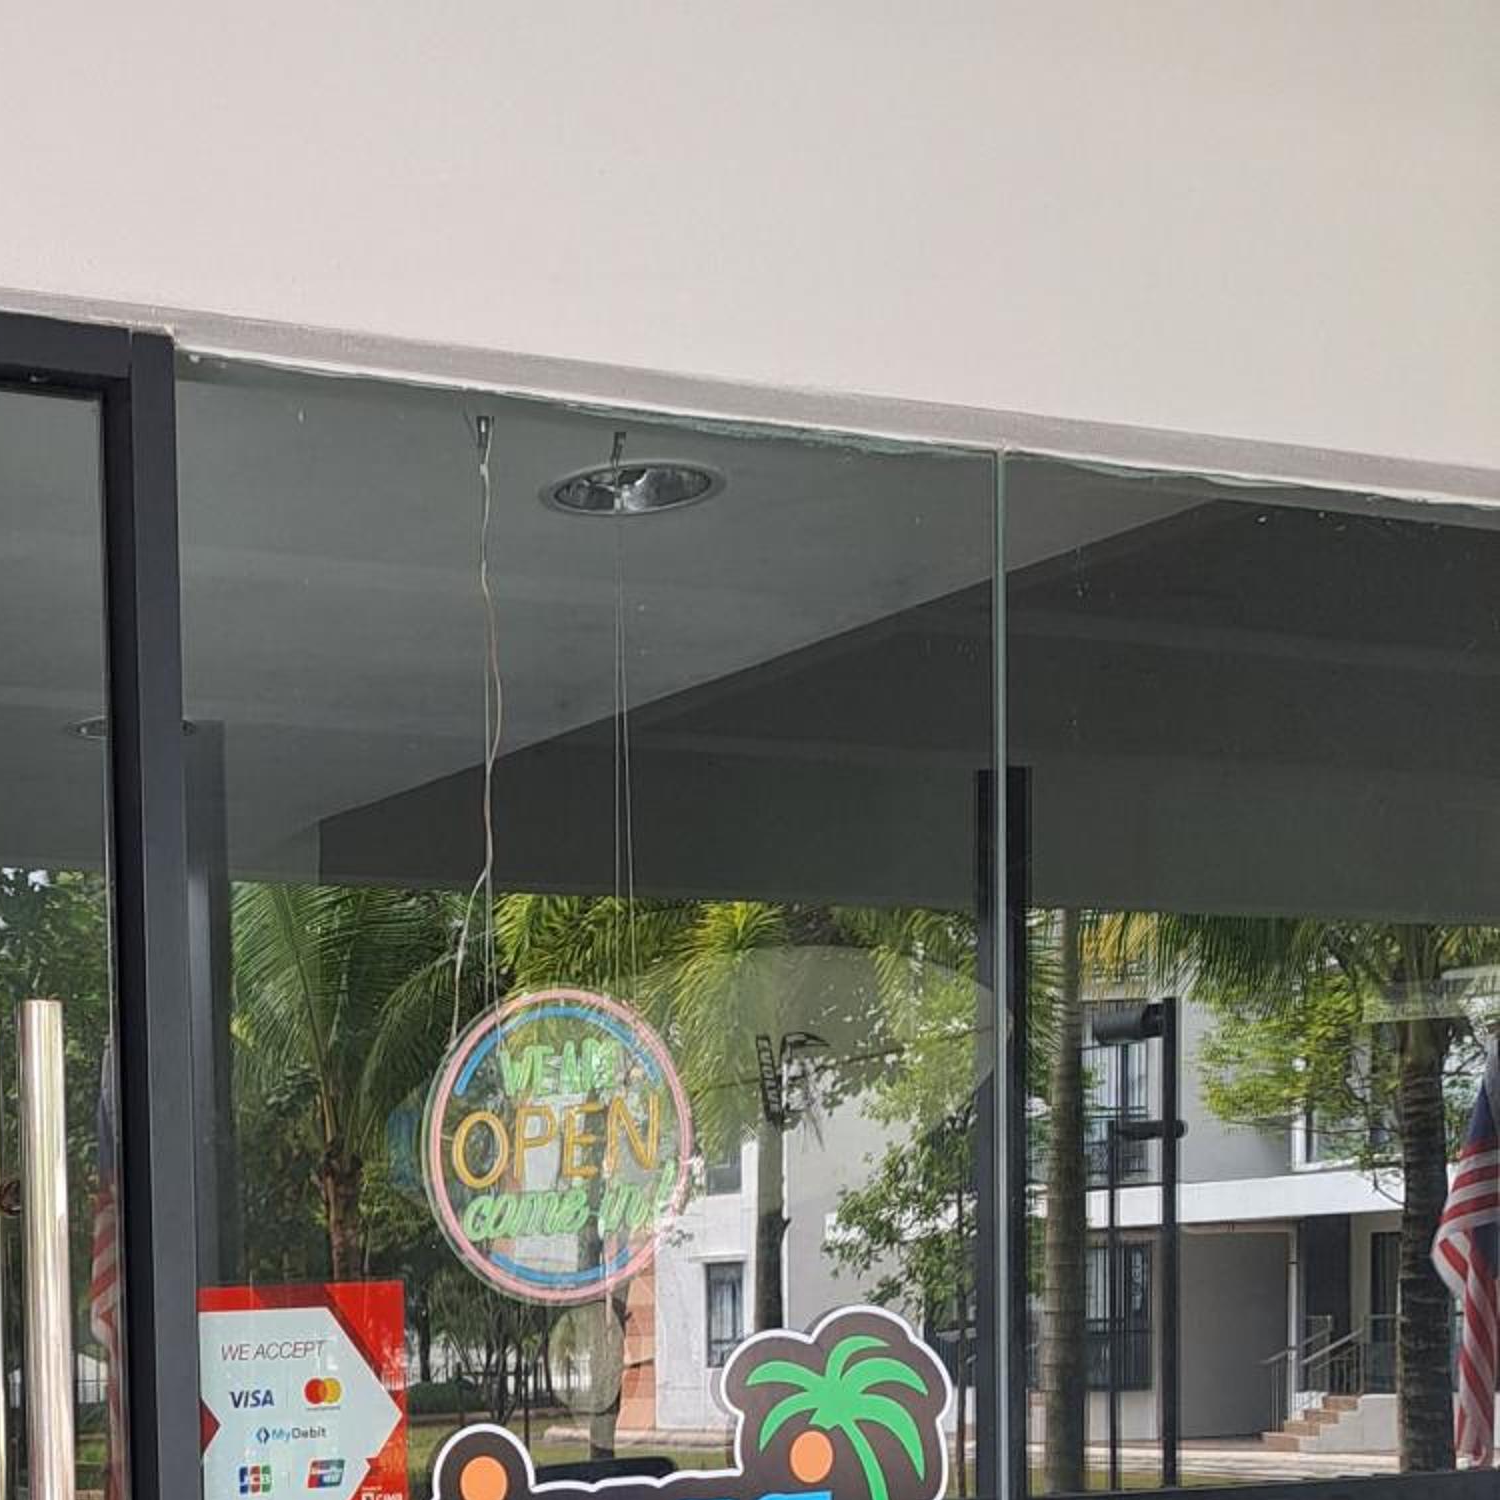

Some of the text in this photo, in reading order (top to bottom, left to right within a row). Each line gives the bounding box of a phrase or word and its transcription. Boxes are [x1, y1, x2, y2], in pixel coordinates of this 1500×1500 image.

[501, 1036, 623, 1096] WE ARE
[452, 1092, 661, 1189] OPEN
[221, 1339, 327, 1361] WE ACCEPT
[230, 1389, 275, 1409] VISA
[271, 1425, 327, 1443] MyDebit
